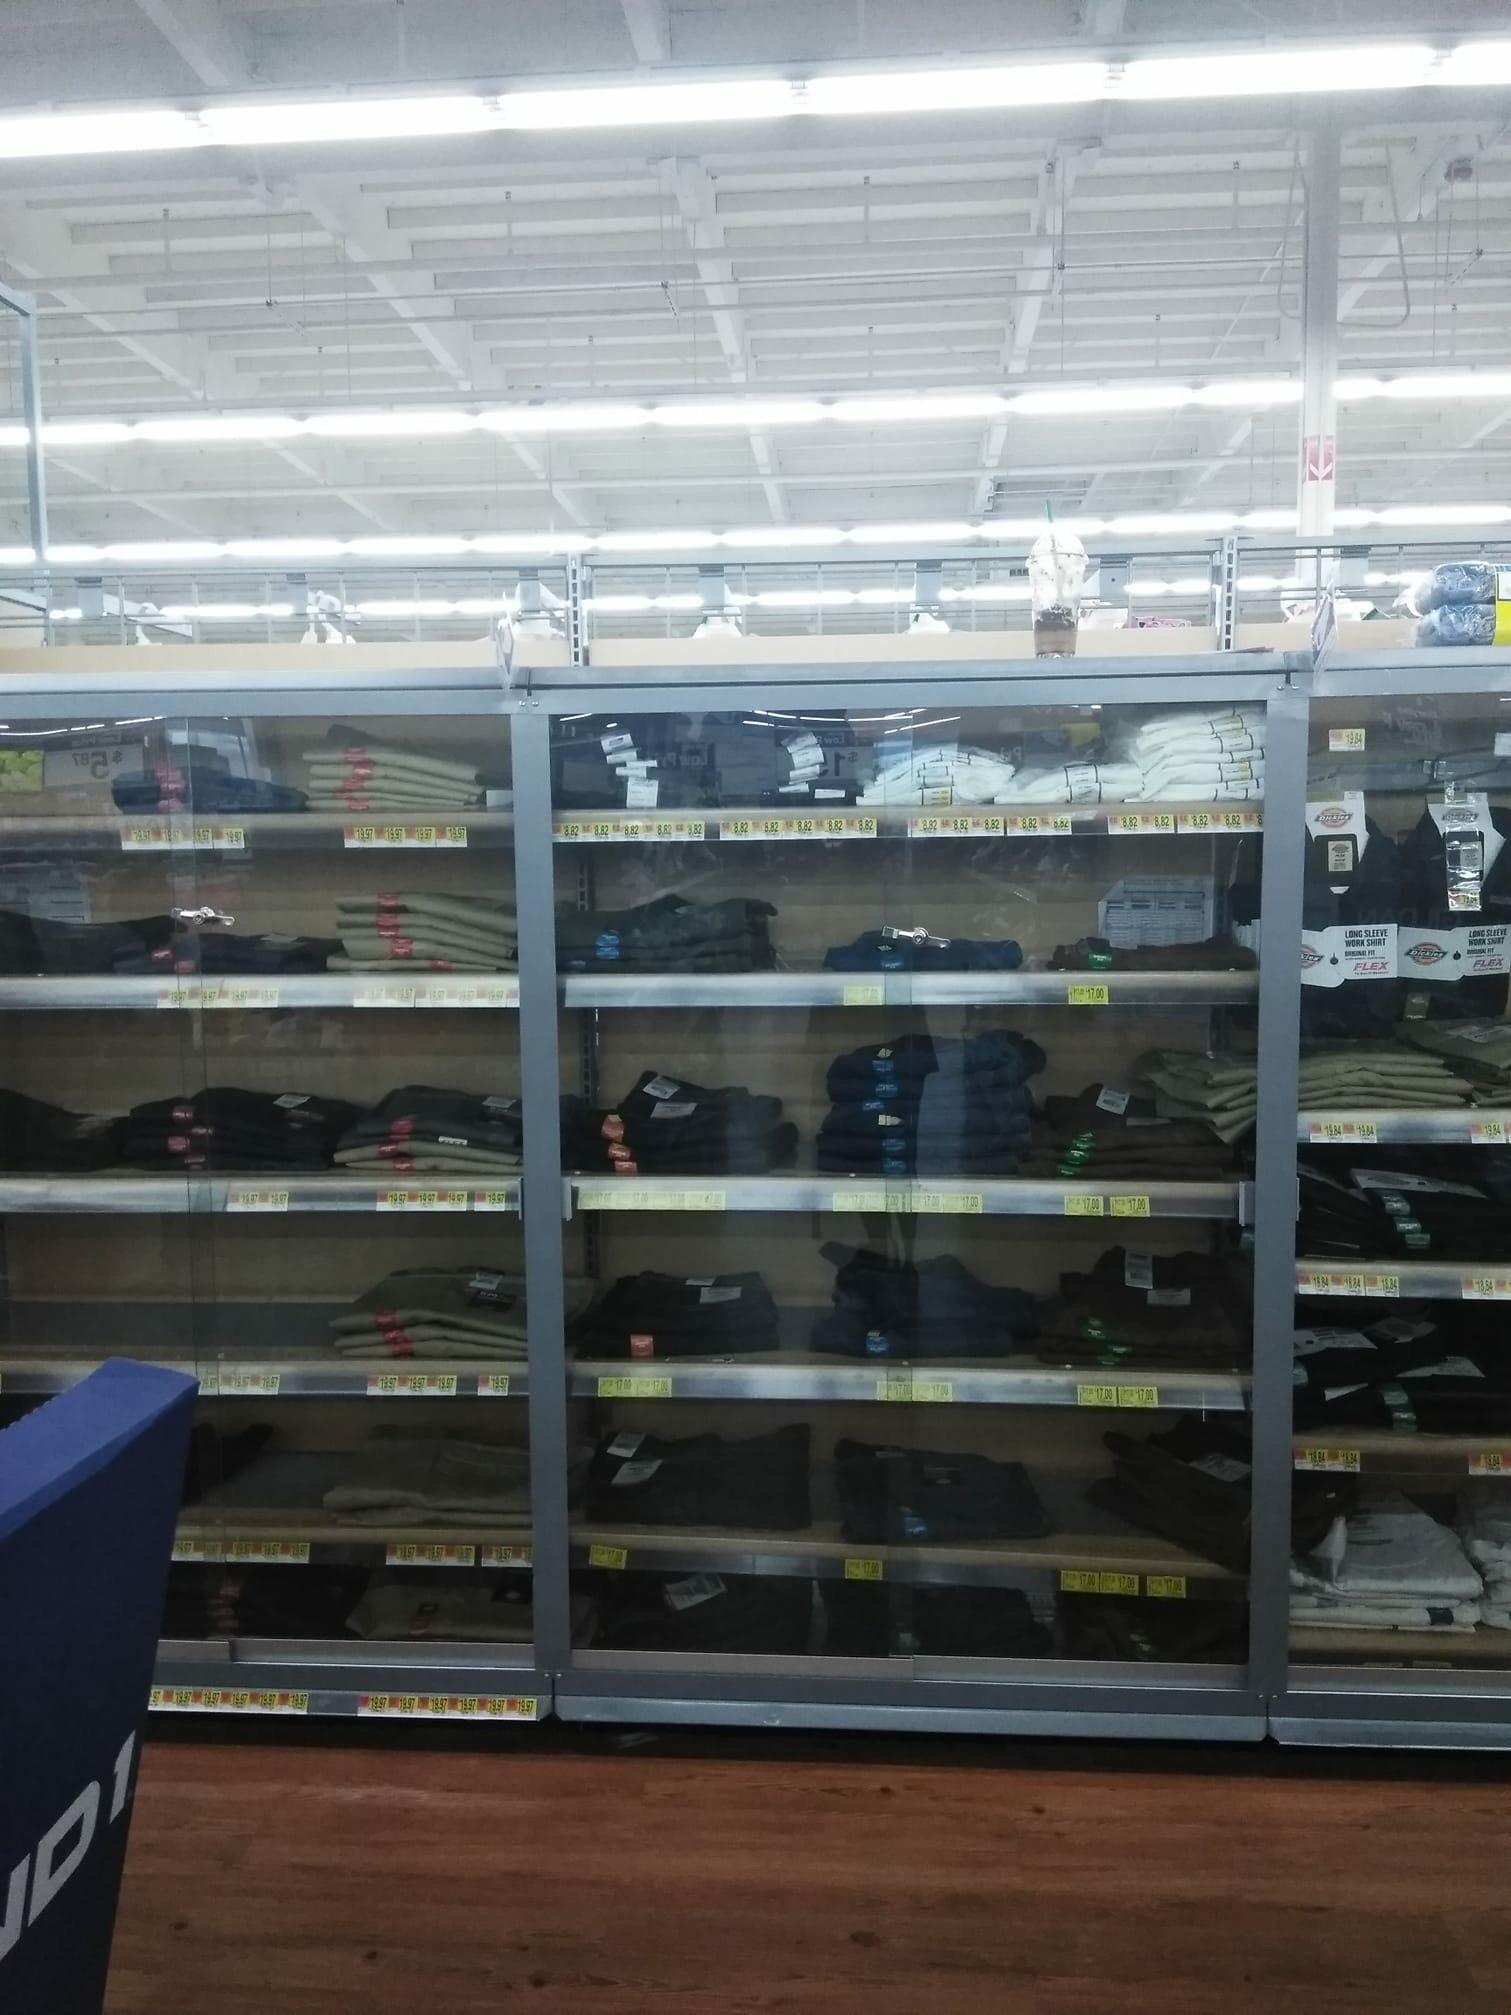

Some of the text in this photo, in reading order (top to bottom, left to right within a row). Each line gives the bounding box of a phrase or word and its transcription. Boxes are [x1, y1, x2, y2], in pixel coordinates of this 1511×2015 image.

[797, 820, 812, 832] 8.82
[828, 820, 843, 831] 8.82
[858, 819, 874, 831] 8.82
[922, 819, 938, 831] 8.82
[953, 818, 969, 830] 8.82
[984, 818, 1000, 830] 8.82
[1021, 817, 1037, 829] 8.82
[1122, 816, 1138, 828] 8.82
[1154, 816, 1170, 827] 8.82
[1192, 815, 1208, 826] 8.82
[1225, 814, 1241, 826] 8.82
[594, 825, 609, 836] 8.82
[624, 824, 639, 836] 8.82
[657, 824, 672, 836] 8.82
[734, 822, 749, 833] 8.82
[764, 821, 779, 832] 8.82
[1345, 929, 1389, 938] LONG SLEEVE
[1469, 928, 1508, 938] LONG SLEEVE
[1345, 938, 1386, 948] WORK SHIRT
[1487, 937, 1505, 946] SHIRT
[1410, 950, 1444, 958] Dickies
[1353, 961, 1390, 972] FLEX
[1473, 959, 1504, 968] FLEX
[1087, 987, 1105, 999] 17.00
[1325, 1124, 1342, 1136] 19.84
[1358, 1124, 1375, 1136] 19.84
[1485, 1123, 1502, 1136] 19.84
[962, 1196, 979, 1208] 17.00
[1083, 1198, 1100, 1210] 17.00
[1128, 1198, 1145, 1210] 17.00
[1096, 1388, 1113, 1400] 17.00
[1137, 1389, 1154, 1401] 17.00
[370, 1696, 388, 1708] 19.97
[400, 1697, 416, 1709] 19.97
[431, 1697, 448, 1709] 19.97
[460, 1698, 477, 1709] 19.97
[489, 1698, 506, 1711] 19.97
[517, 1700, 534, 1711] 19.97
